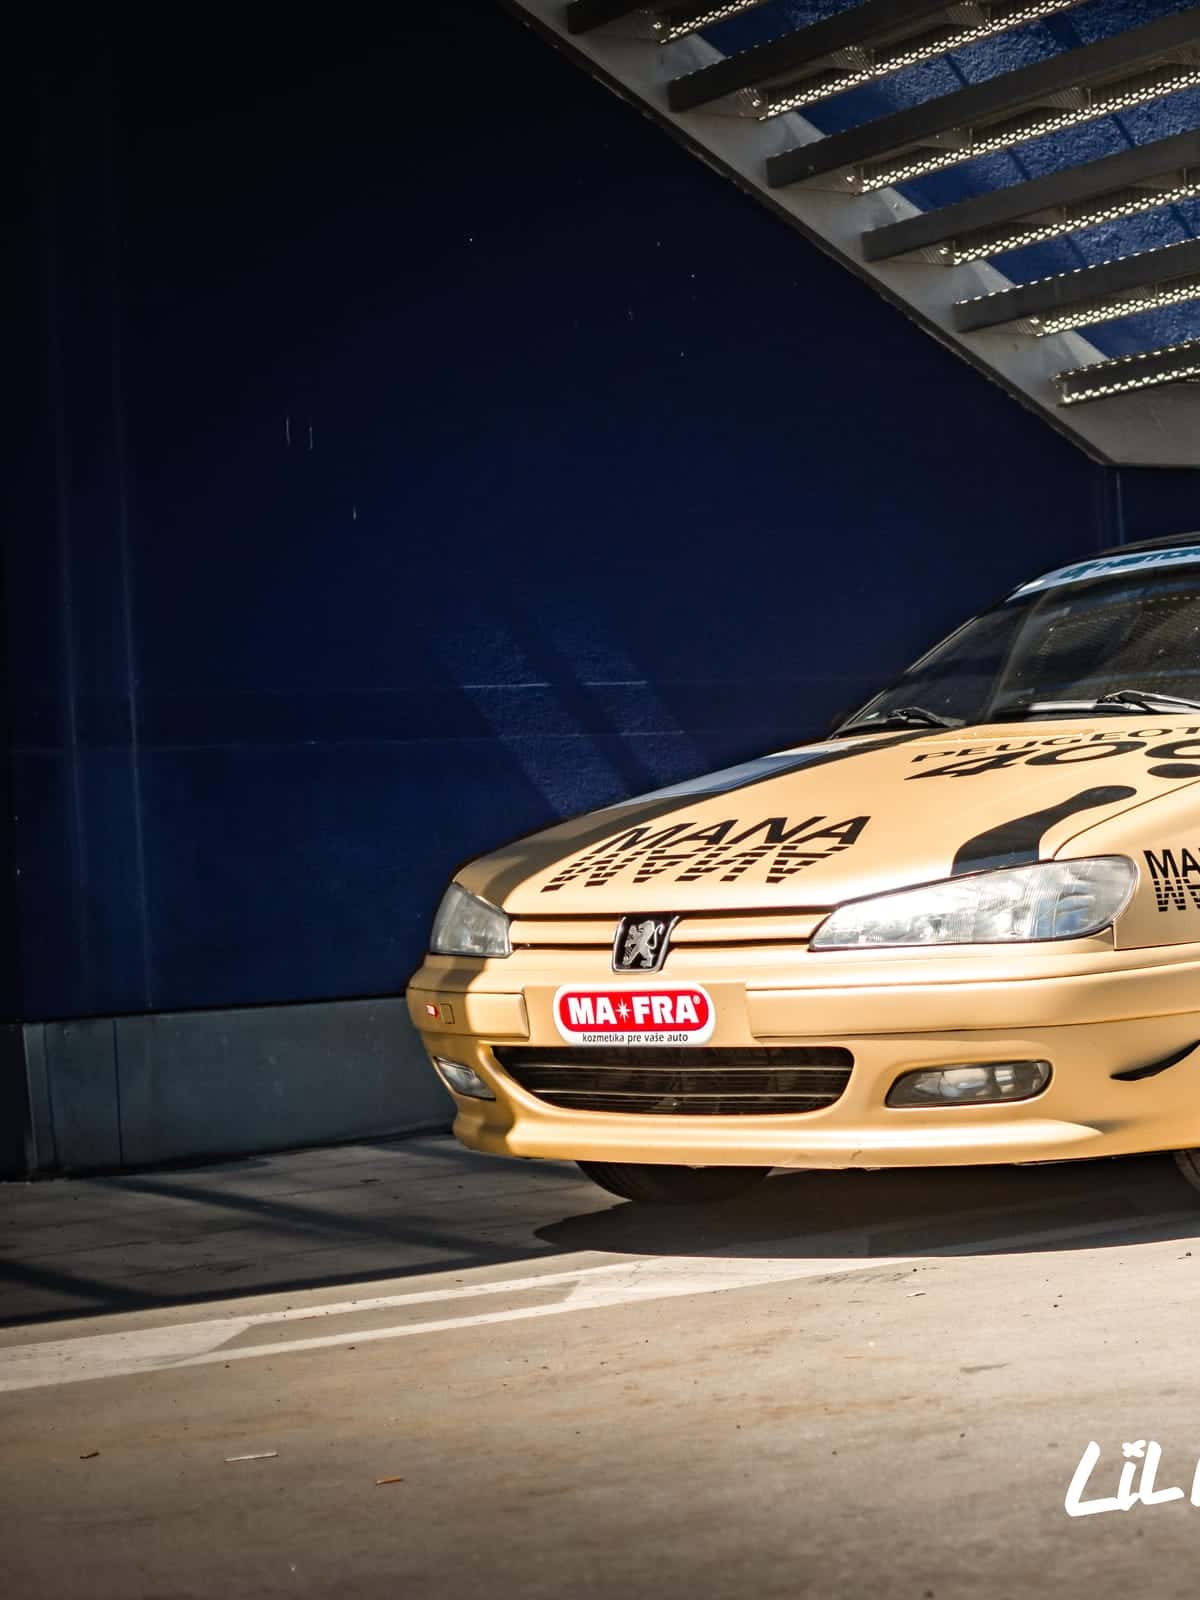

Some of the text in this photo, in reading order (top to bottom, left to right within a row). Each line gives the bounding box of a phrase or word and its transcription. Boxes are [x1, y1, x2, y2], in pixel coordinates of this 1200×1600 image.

[588, 815, 872, 852] MANA
[582, 1032, 689, 1044] kozmetika pre vaše auto
